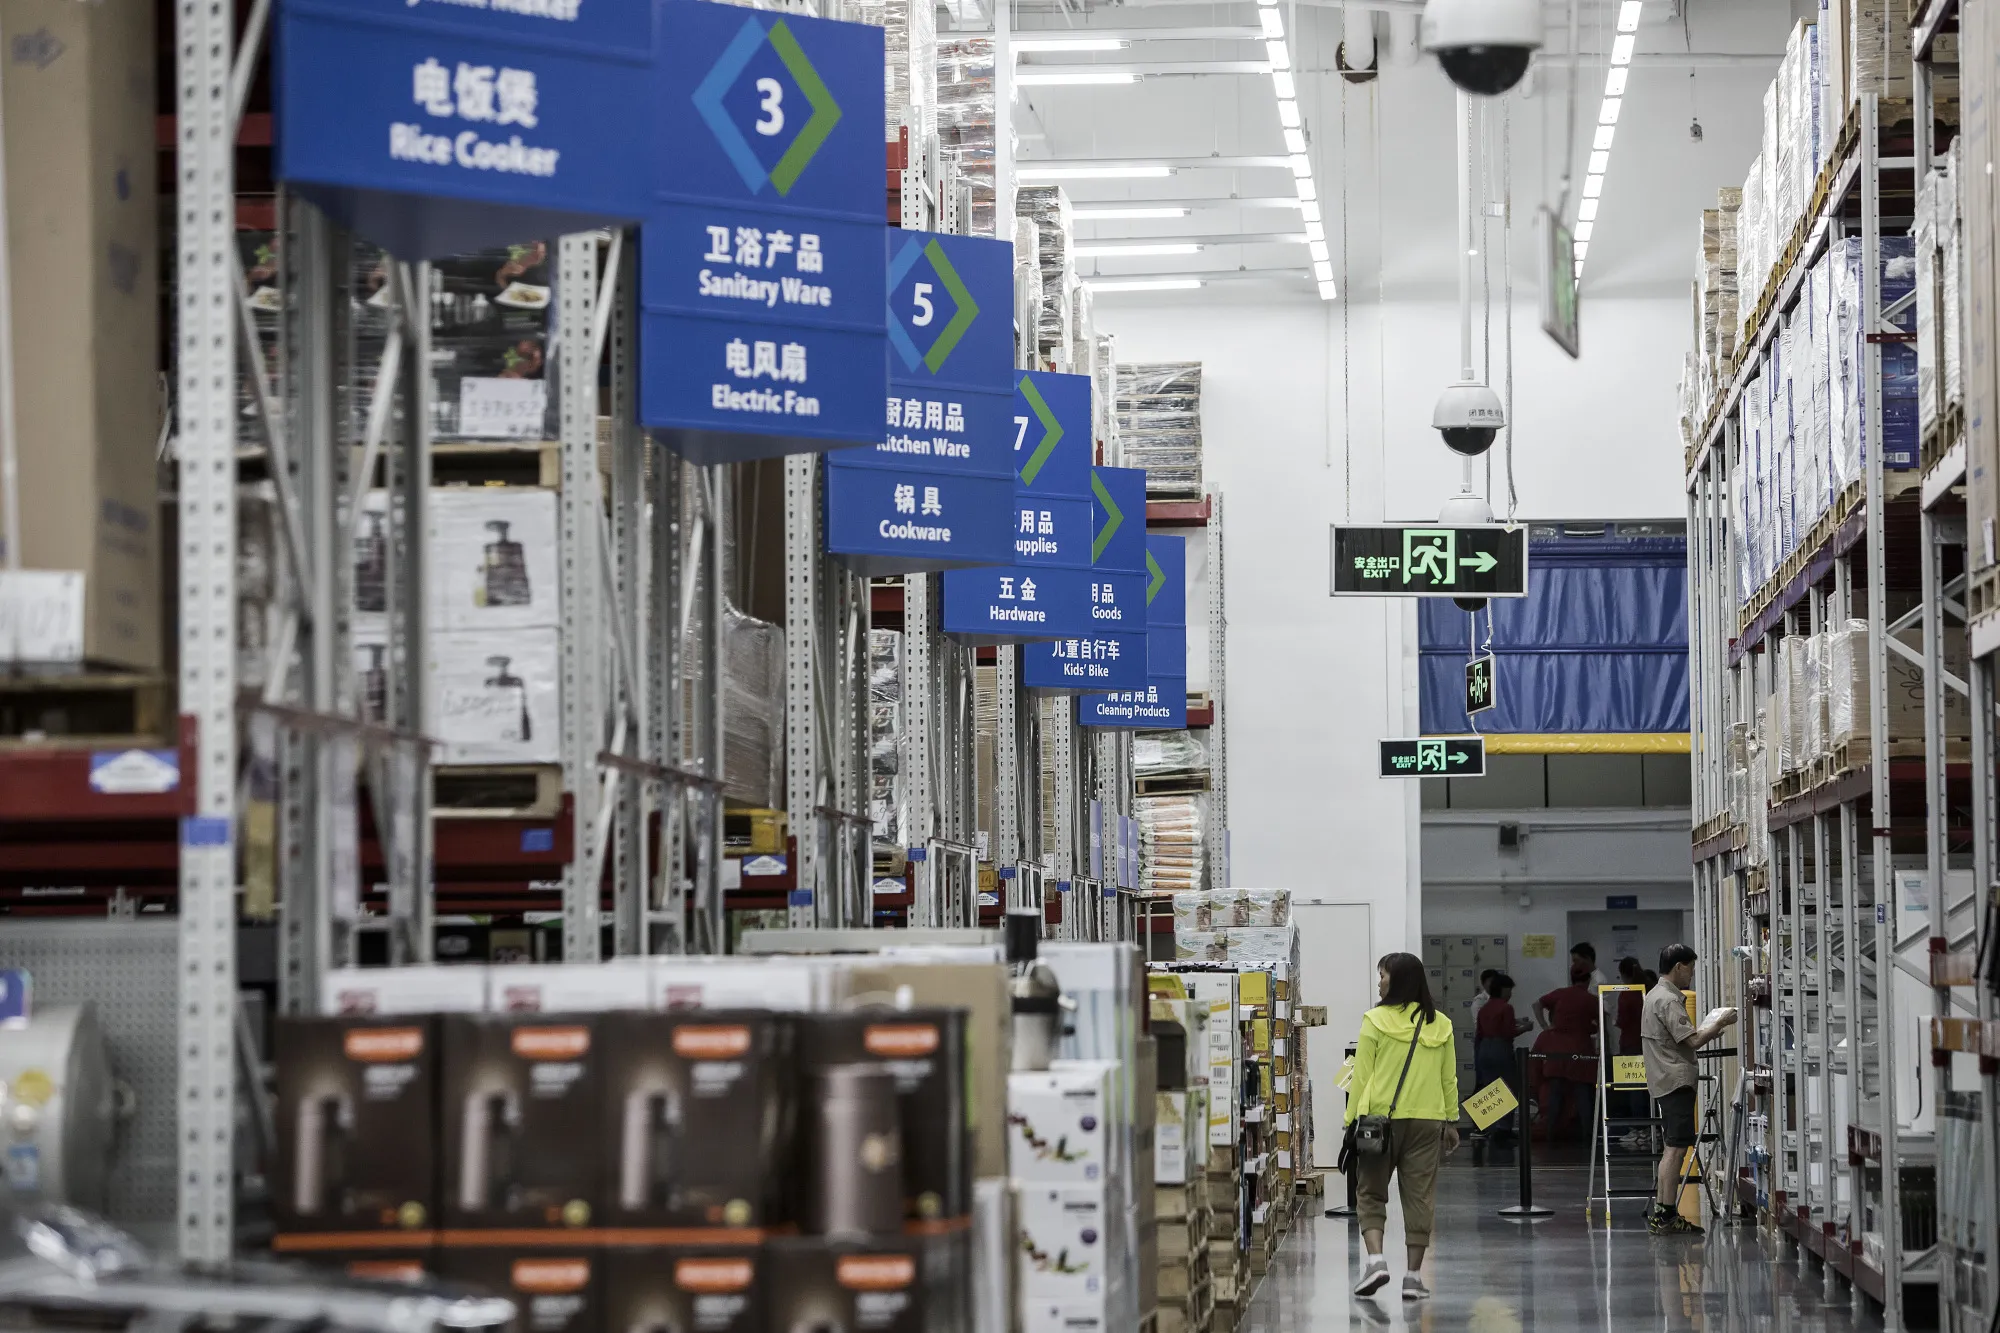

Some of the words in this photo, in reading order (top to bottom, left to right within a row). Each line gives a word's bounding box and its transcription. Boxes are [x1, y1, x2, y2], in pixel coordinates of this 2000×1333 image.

[413, 57, 539, 129] 电饭煲
[755, 77, 785, 136] 3
[389, 121, 453, 166] Rice
[454, 130, 560, 178] Cooker
[703, 225, 823, 273] 卫浴产品
[699, 269, 779, 308] Sanitary
[781, 276, 831, 307] Ware
[912, 282, 934, 327] 5
[726, 337, 807, 383] 电风扇
[712, 384, 783, 414] Electric
[784, 390, 820, 416] Fan
[1014, 416, 1029, 451] 7
[933, 437, 970, 458] Ware
[894, 483, 942, 516] 锅具
[879, 519, 951, 542] Cookware
[1014, 509, 1053, 535] 用品
[1354, 556, 1400, 570] 安全出口
[1363, 569, 1392, 579] EXIT
[998, 577, 1037, 602] 五金
[990, 605, 1046, 622] Hardware
[1092, 606, 1122, 620] Goods
[1052, 639, 1120, 660] 儿童自行车
[1088, 664, 1109, 677] Bike
[1096, 703, 1132, 719] Cleaning
[1134, 705, 1170, 717] Products
